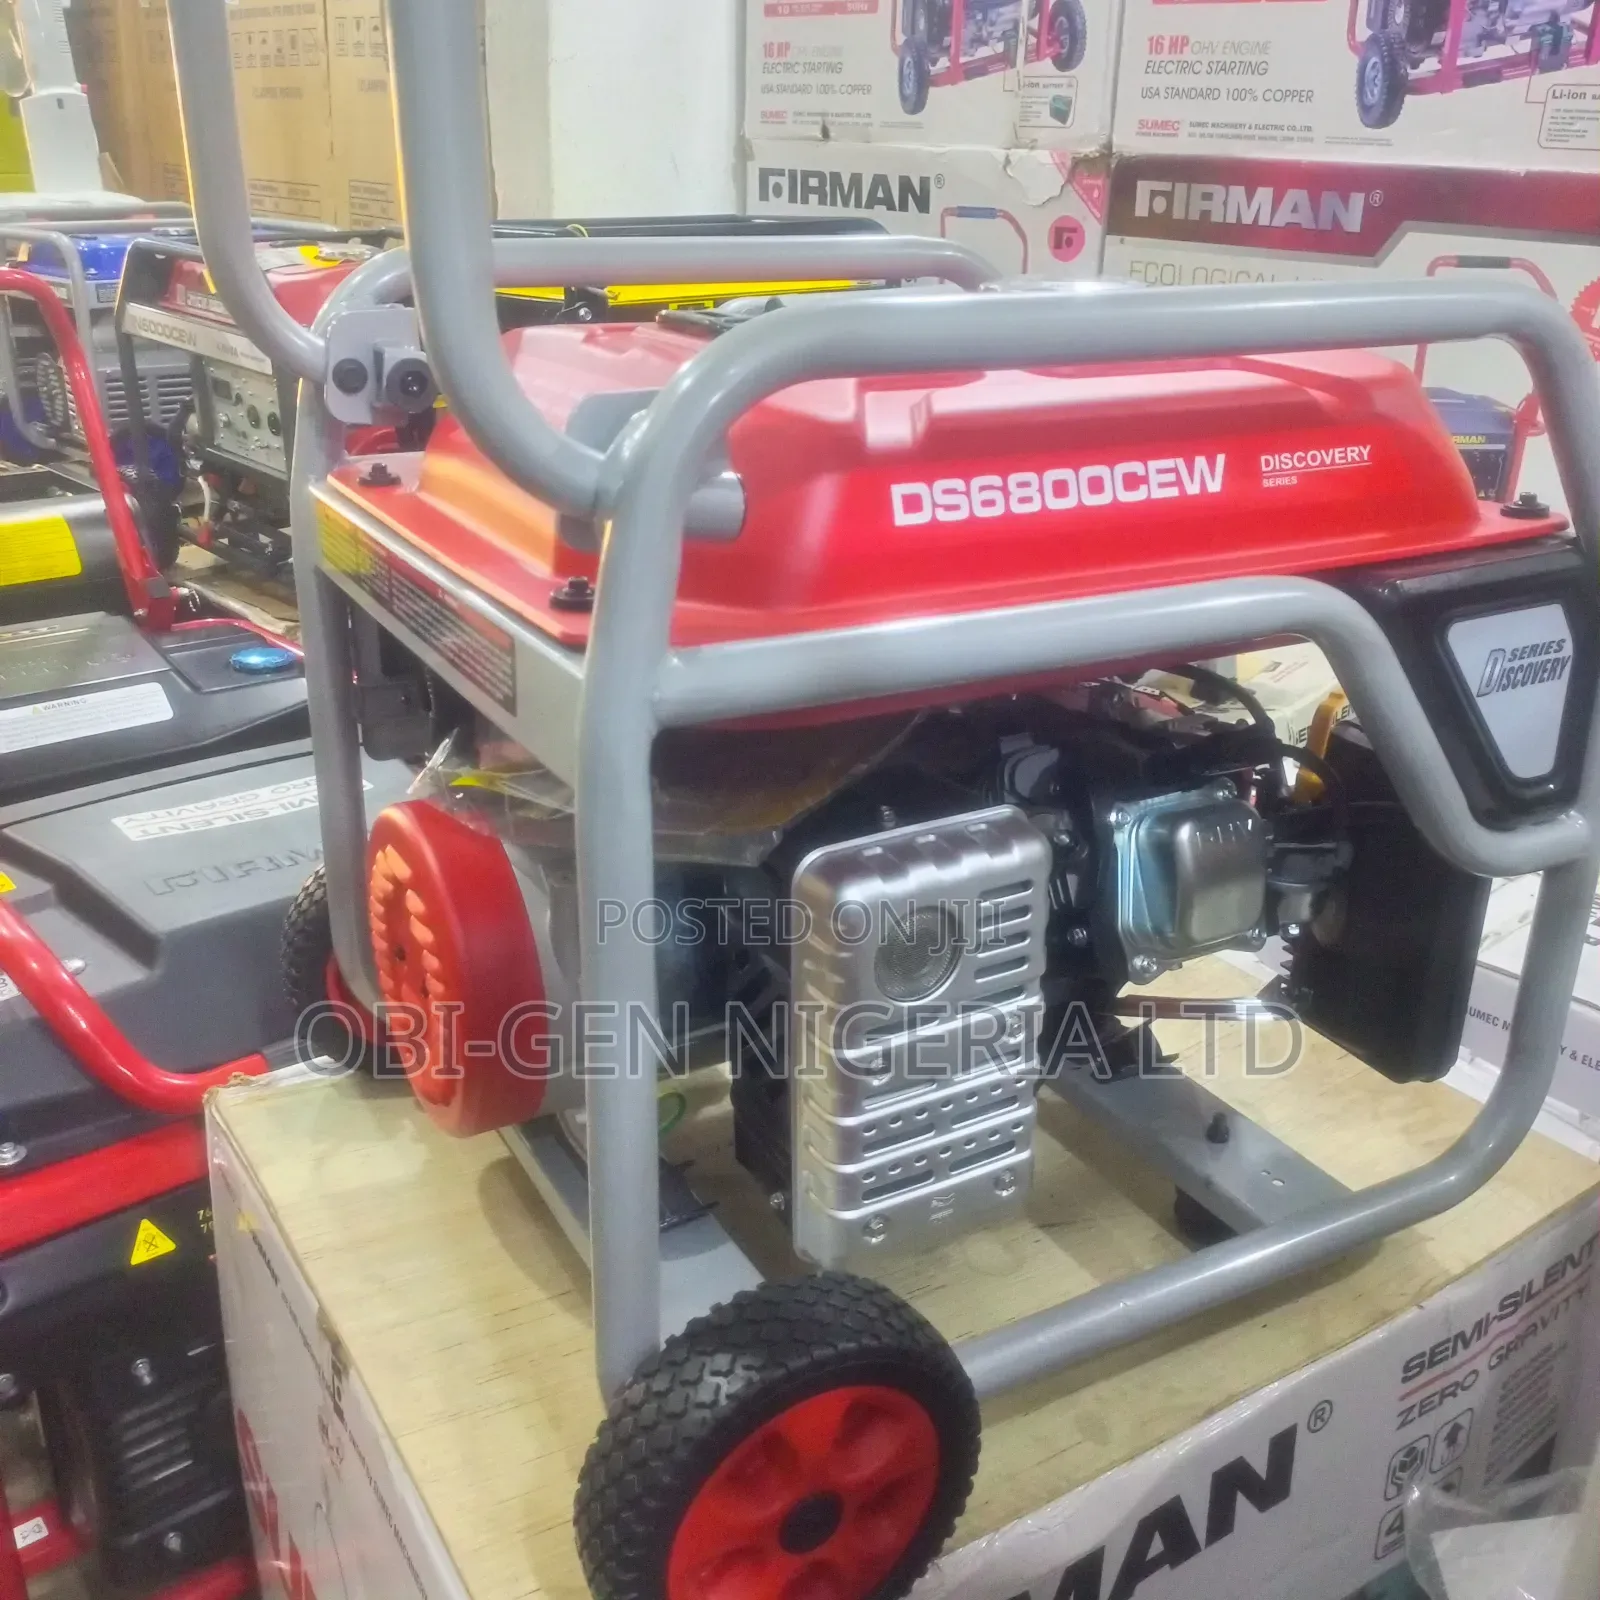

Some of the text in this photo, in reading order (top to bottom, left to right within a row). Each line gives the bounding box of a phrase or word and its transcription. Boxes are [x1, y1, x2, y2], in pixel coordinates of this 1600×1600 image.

[1147, 35, 1272, 56] 16 HP OHV ENGINE
[762, 61, 844, 74] ELECTRIC STARTING
[1144, 60, 1269, 76] ELECTRIC STARTING
[776, 84, 813, 95] STANDARD
[840, 84, 872, 96] COPPER
[1141, 86, 1315, 103] USA STANDARD 100% COPPER
[1551, 88, 1587, 100] Li-ion
[1138, 119, 1180, 131] SUMEC
[1254, 123, 1285, 131] ELECTRIC
[758, 167, 931, 214] FIRMAN
[1134, 180, 1365, 233] FIRMAN
[1452, 435, 1486, 445] RMAN
[890, 445, 1373, 527] DS6800CEW DISCOVERY
[1262, 474, 1298, 488] SERIES
[1508, 638, 1566, 663] SERIES
[43, 697, 88, 711] WARNING
[1468, 1005, 1500, 1028] UMEC
[1396, 1368, 1480, 1432] ZERO
